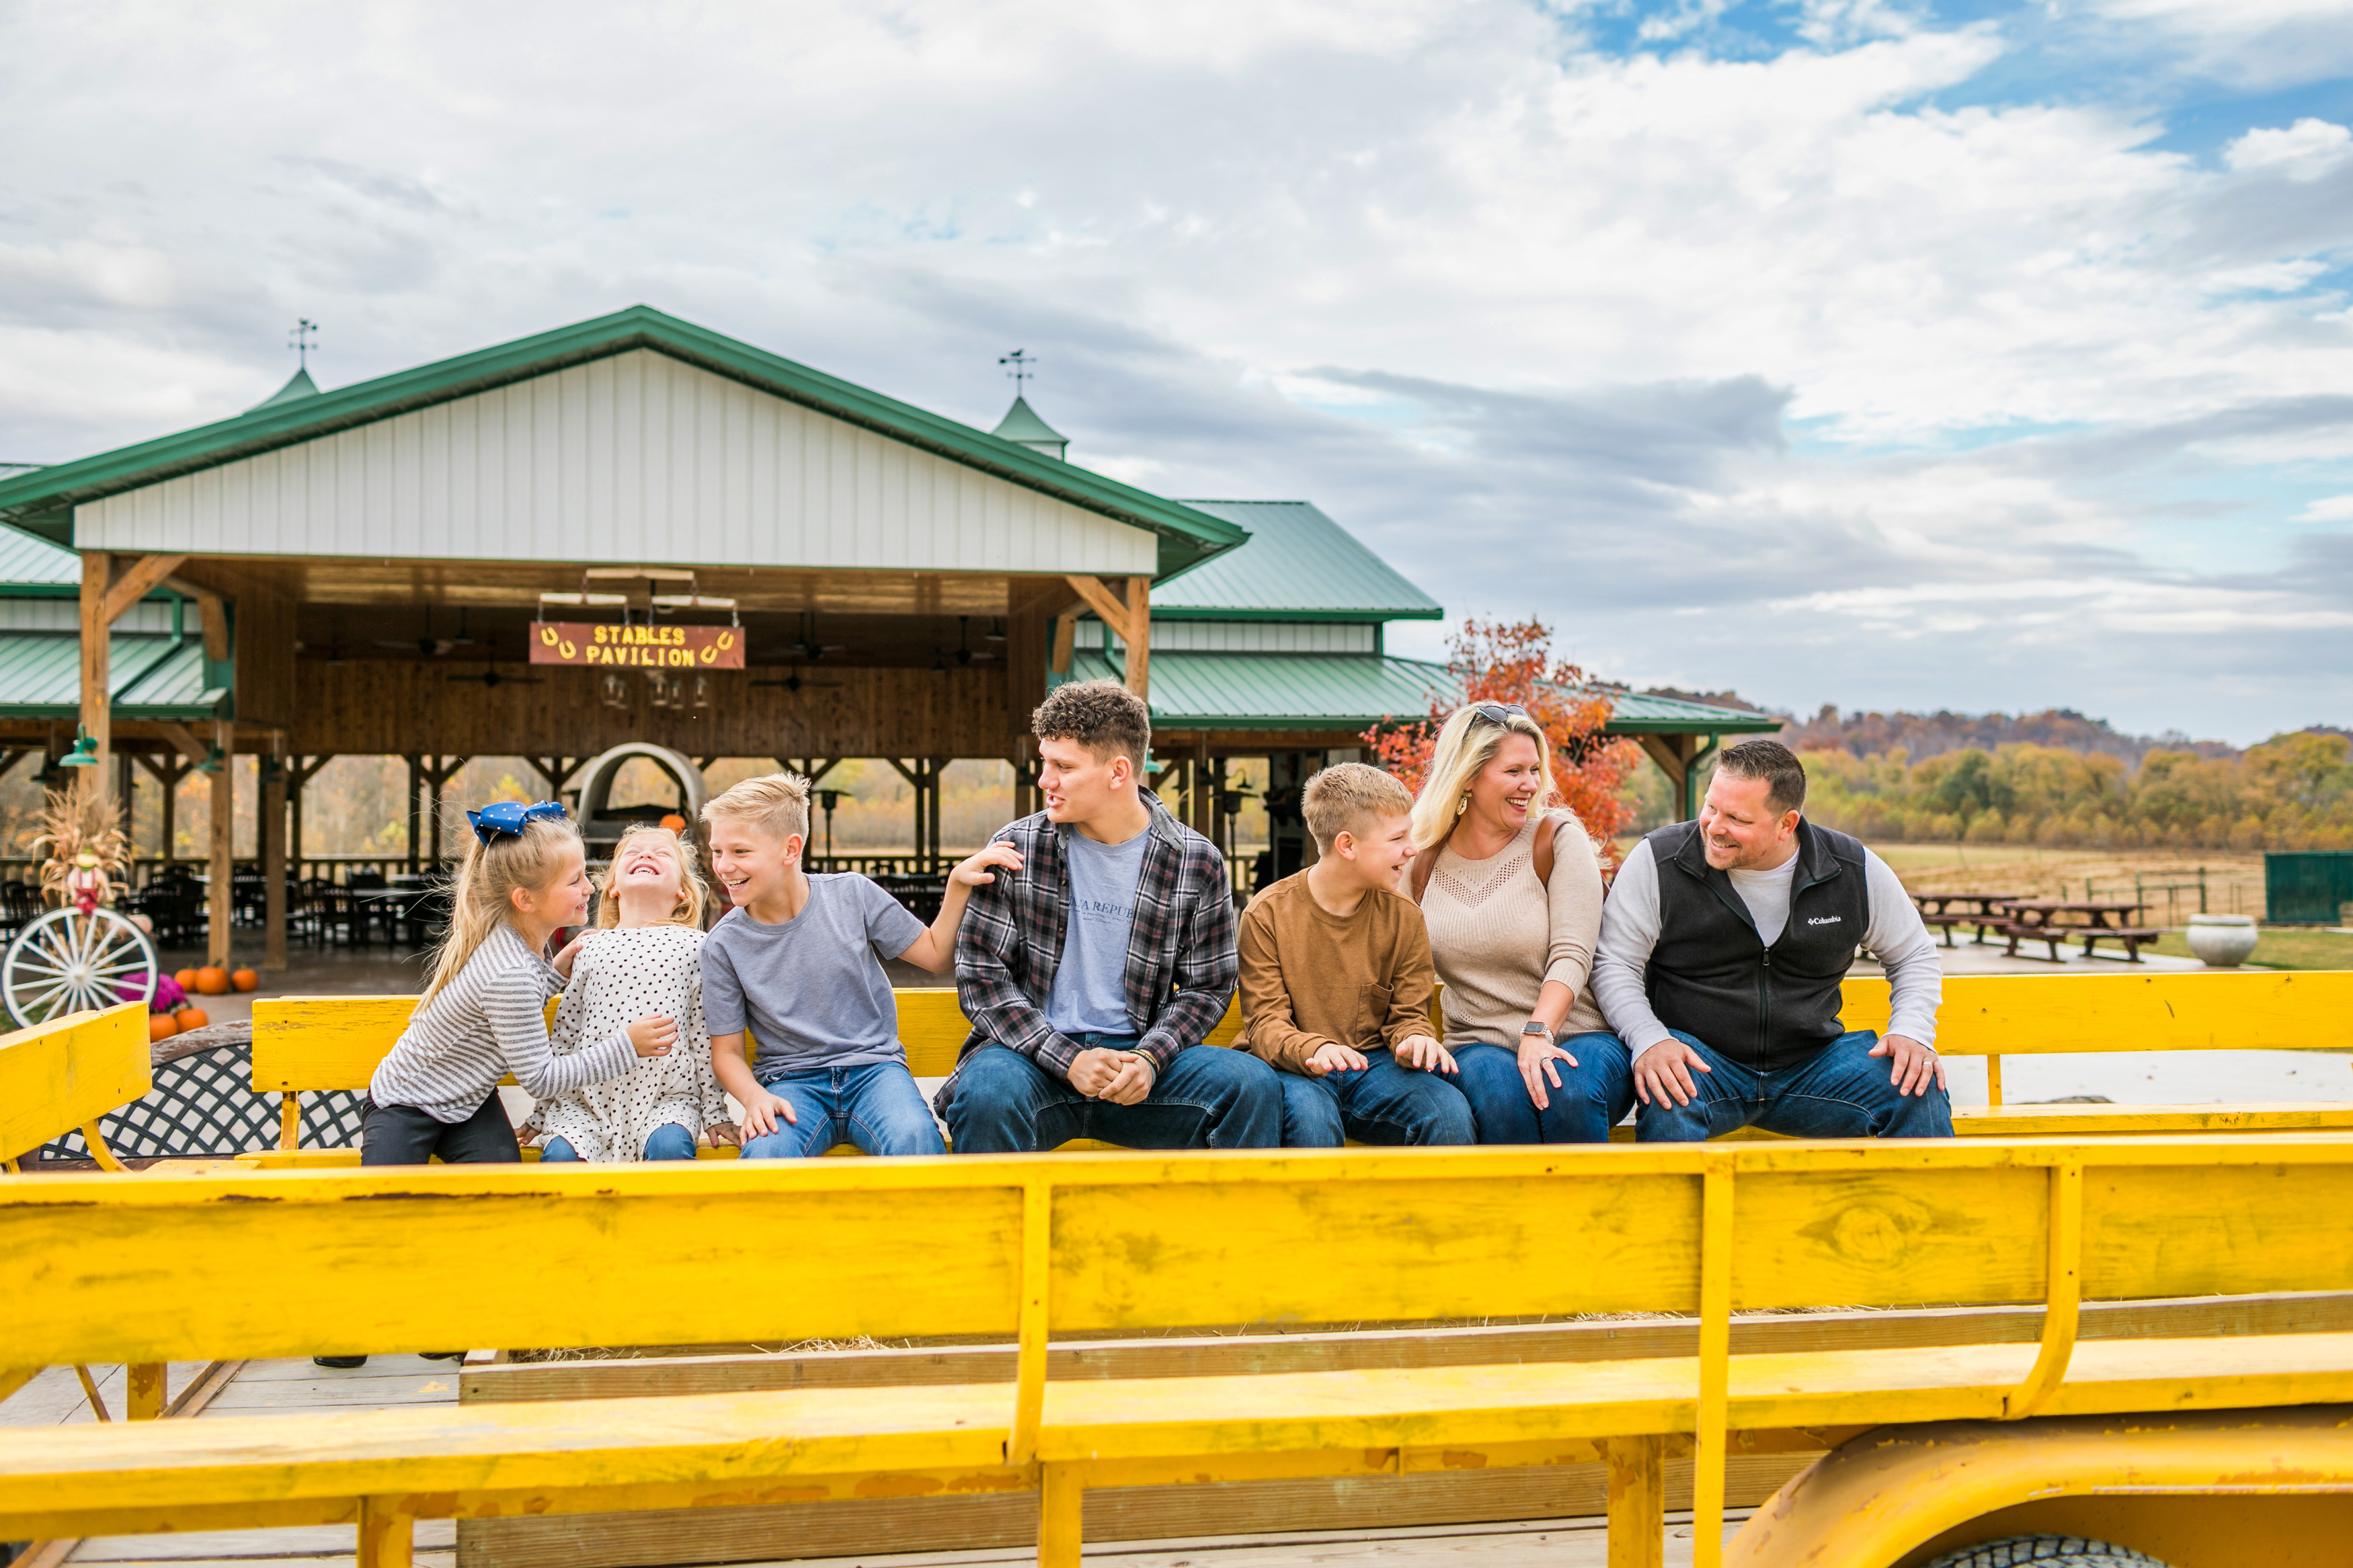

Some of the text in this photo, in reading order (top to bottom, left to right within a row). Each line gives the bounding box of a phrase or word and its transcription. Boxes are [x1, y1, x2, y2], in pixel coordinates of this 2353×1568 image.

[594, 626, 686, 646] STABLES
[586, 645, 696, 667] PAVILION
[1814, 915, 1841, 925] Columbia
